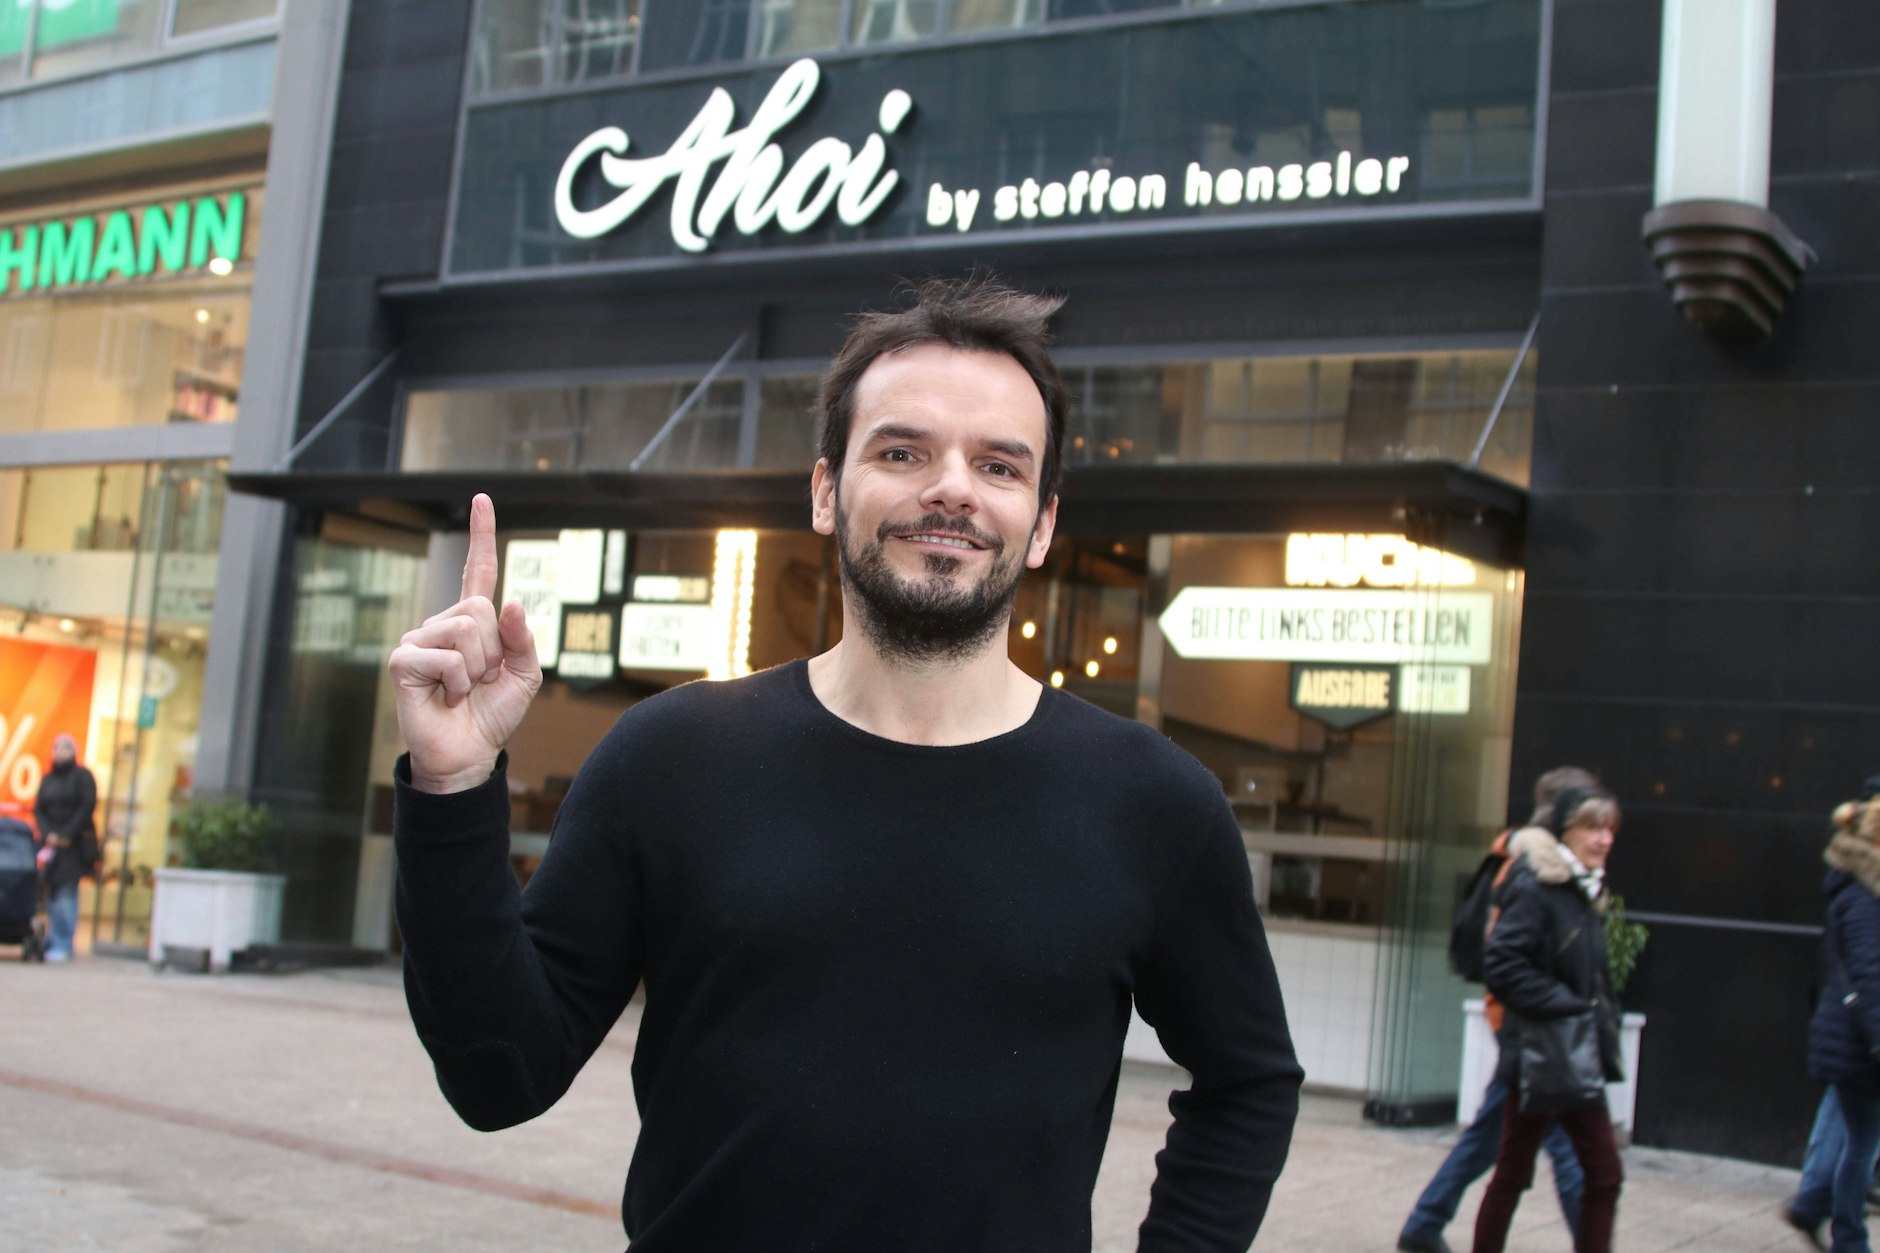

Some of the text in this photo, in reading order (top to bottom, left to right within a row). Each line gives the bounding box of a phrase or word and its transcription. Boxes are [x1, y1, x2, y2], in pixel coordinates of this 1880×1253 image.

[555, 58, 912, 252] Ahoi
[926, 150, 1409, 233] by steffen henssler
